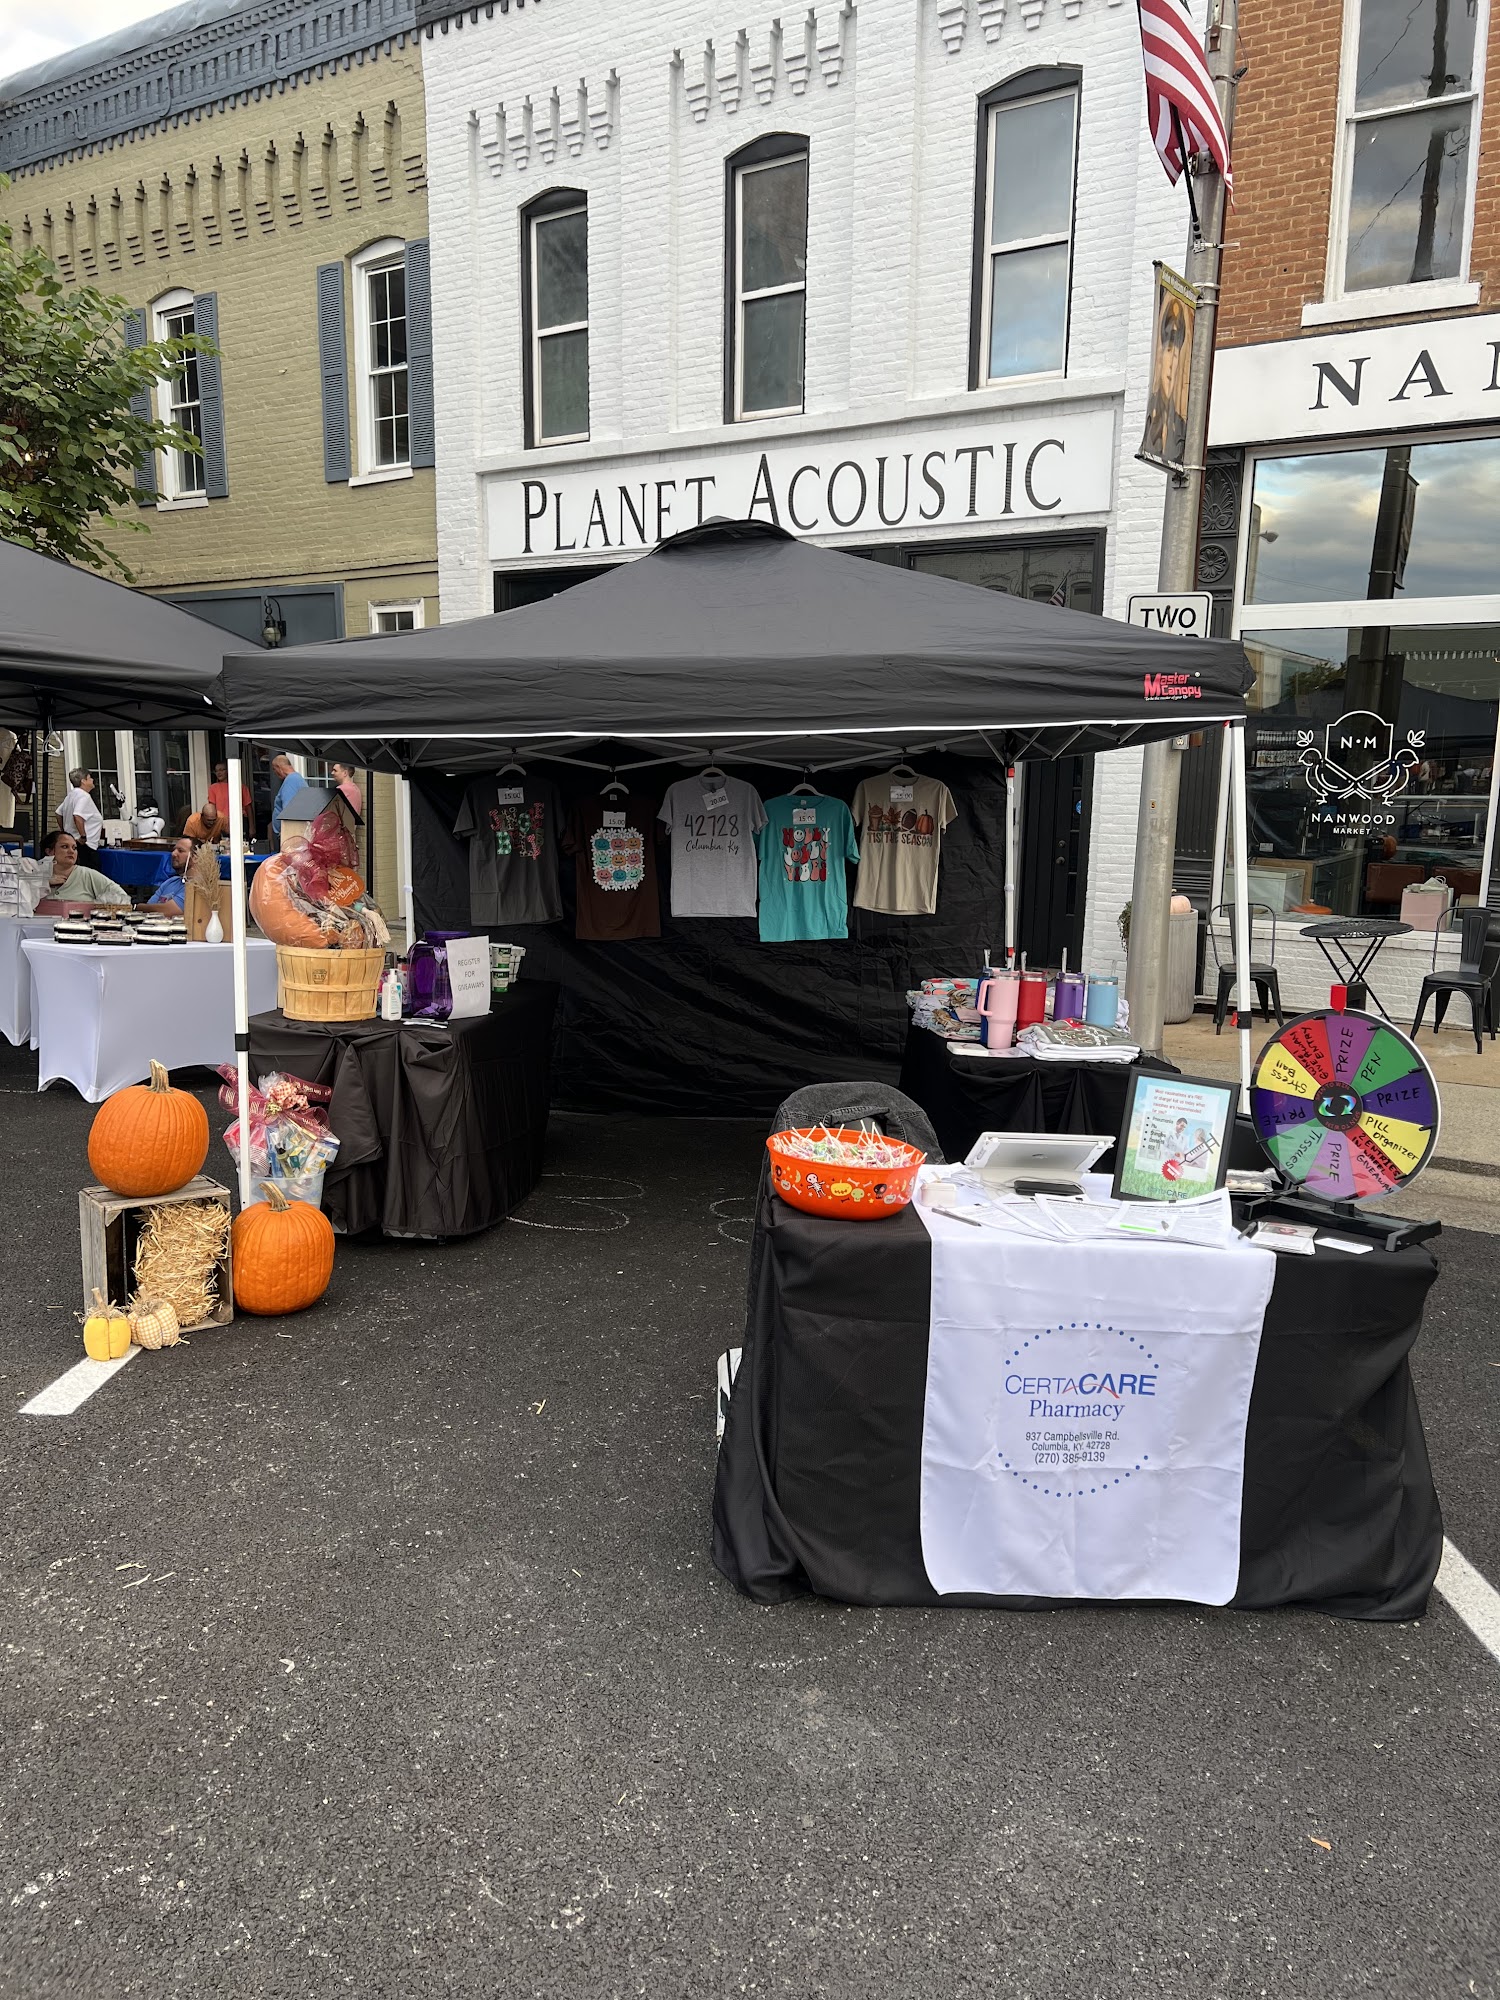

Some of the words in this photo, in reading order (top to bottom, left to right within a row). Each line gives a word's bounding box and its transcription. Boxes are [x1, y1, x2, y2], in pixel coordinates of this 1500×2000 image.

[1308, 341, 1500, 411] NA
[521, 475, 716, 554] PLANET
[746, 438, 1066, 531] ACOUSTIC
[1140, 606, 1196, 629] TWO
[1144, 672, 1190, 697] Master
[1161, 685, 1202, 699] Canopy
[684, 814, 740, 837] 42728
[1311, 813, 1396, 825] NANWOOD
[901, 833, 933, 848] SEASON
[1333, 827, 1371, 835] MARKET
[457, 957, 481, 967] REGISTER
[464, 970, 475, 978] FOR
[457, 981, 485, 992] GIVEAWAYS
[1301, 1027, 1325, 1059] ENTRY
[1335, 1027, 1354, 1073] PRIZE
[1361, 1051, 1382, 1083] PEN
[1377, 1087, 1421, 1107] PRIZE
[1262, 1106, 1306, 1126] PRIZE
[1365, 1116, 1389, 1134] PILL
[1351, 1136, 1362, 1148] IN
[1328, 1142, 1342, 1183] PRIZE
[1364, 1139, 1401, 1179] ENTRIES
[1356, 1154, 1395, 1196] GIVEAWAY
[1028, 1399, 1125, 1421] Pharmacy
[1025, 1431, 1042, 1442] 937
[1043, 1431, 1103, 1443] Campbellsville
[1105, 1431, 1120, 1441] Rd.
[1031, 1442, 1071, 1452] Columbia,
[1085, 1441, 1111, 1450] 42728
[1034, 1452, 1060, 1465] (270)
[1062, 1451, 1106, 1464] 385-9139
